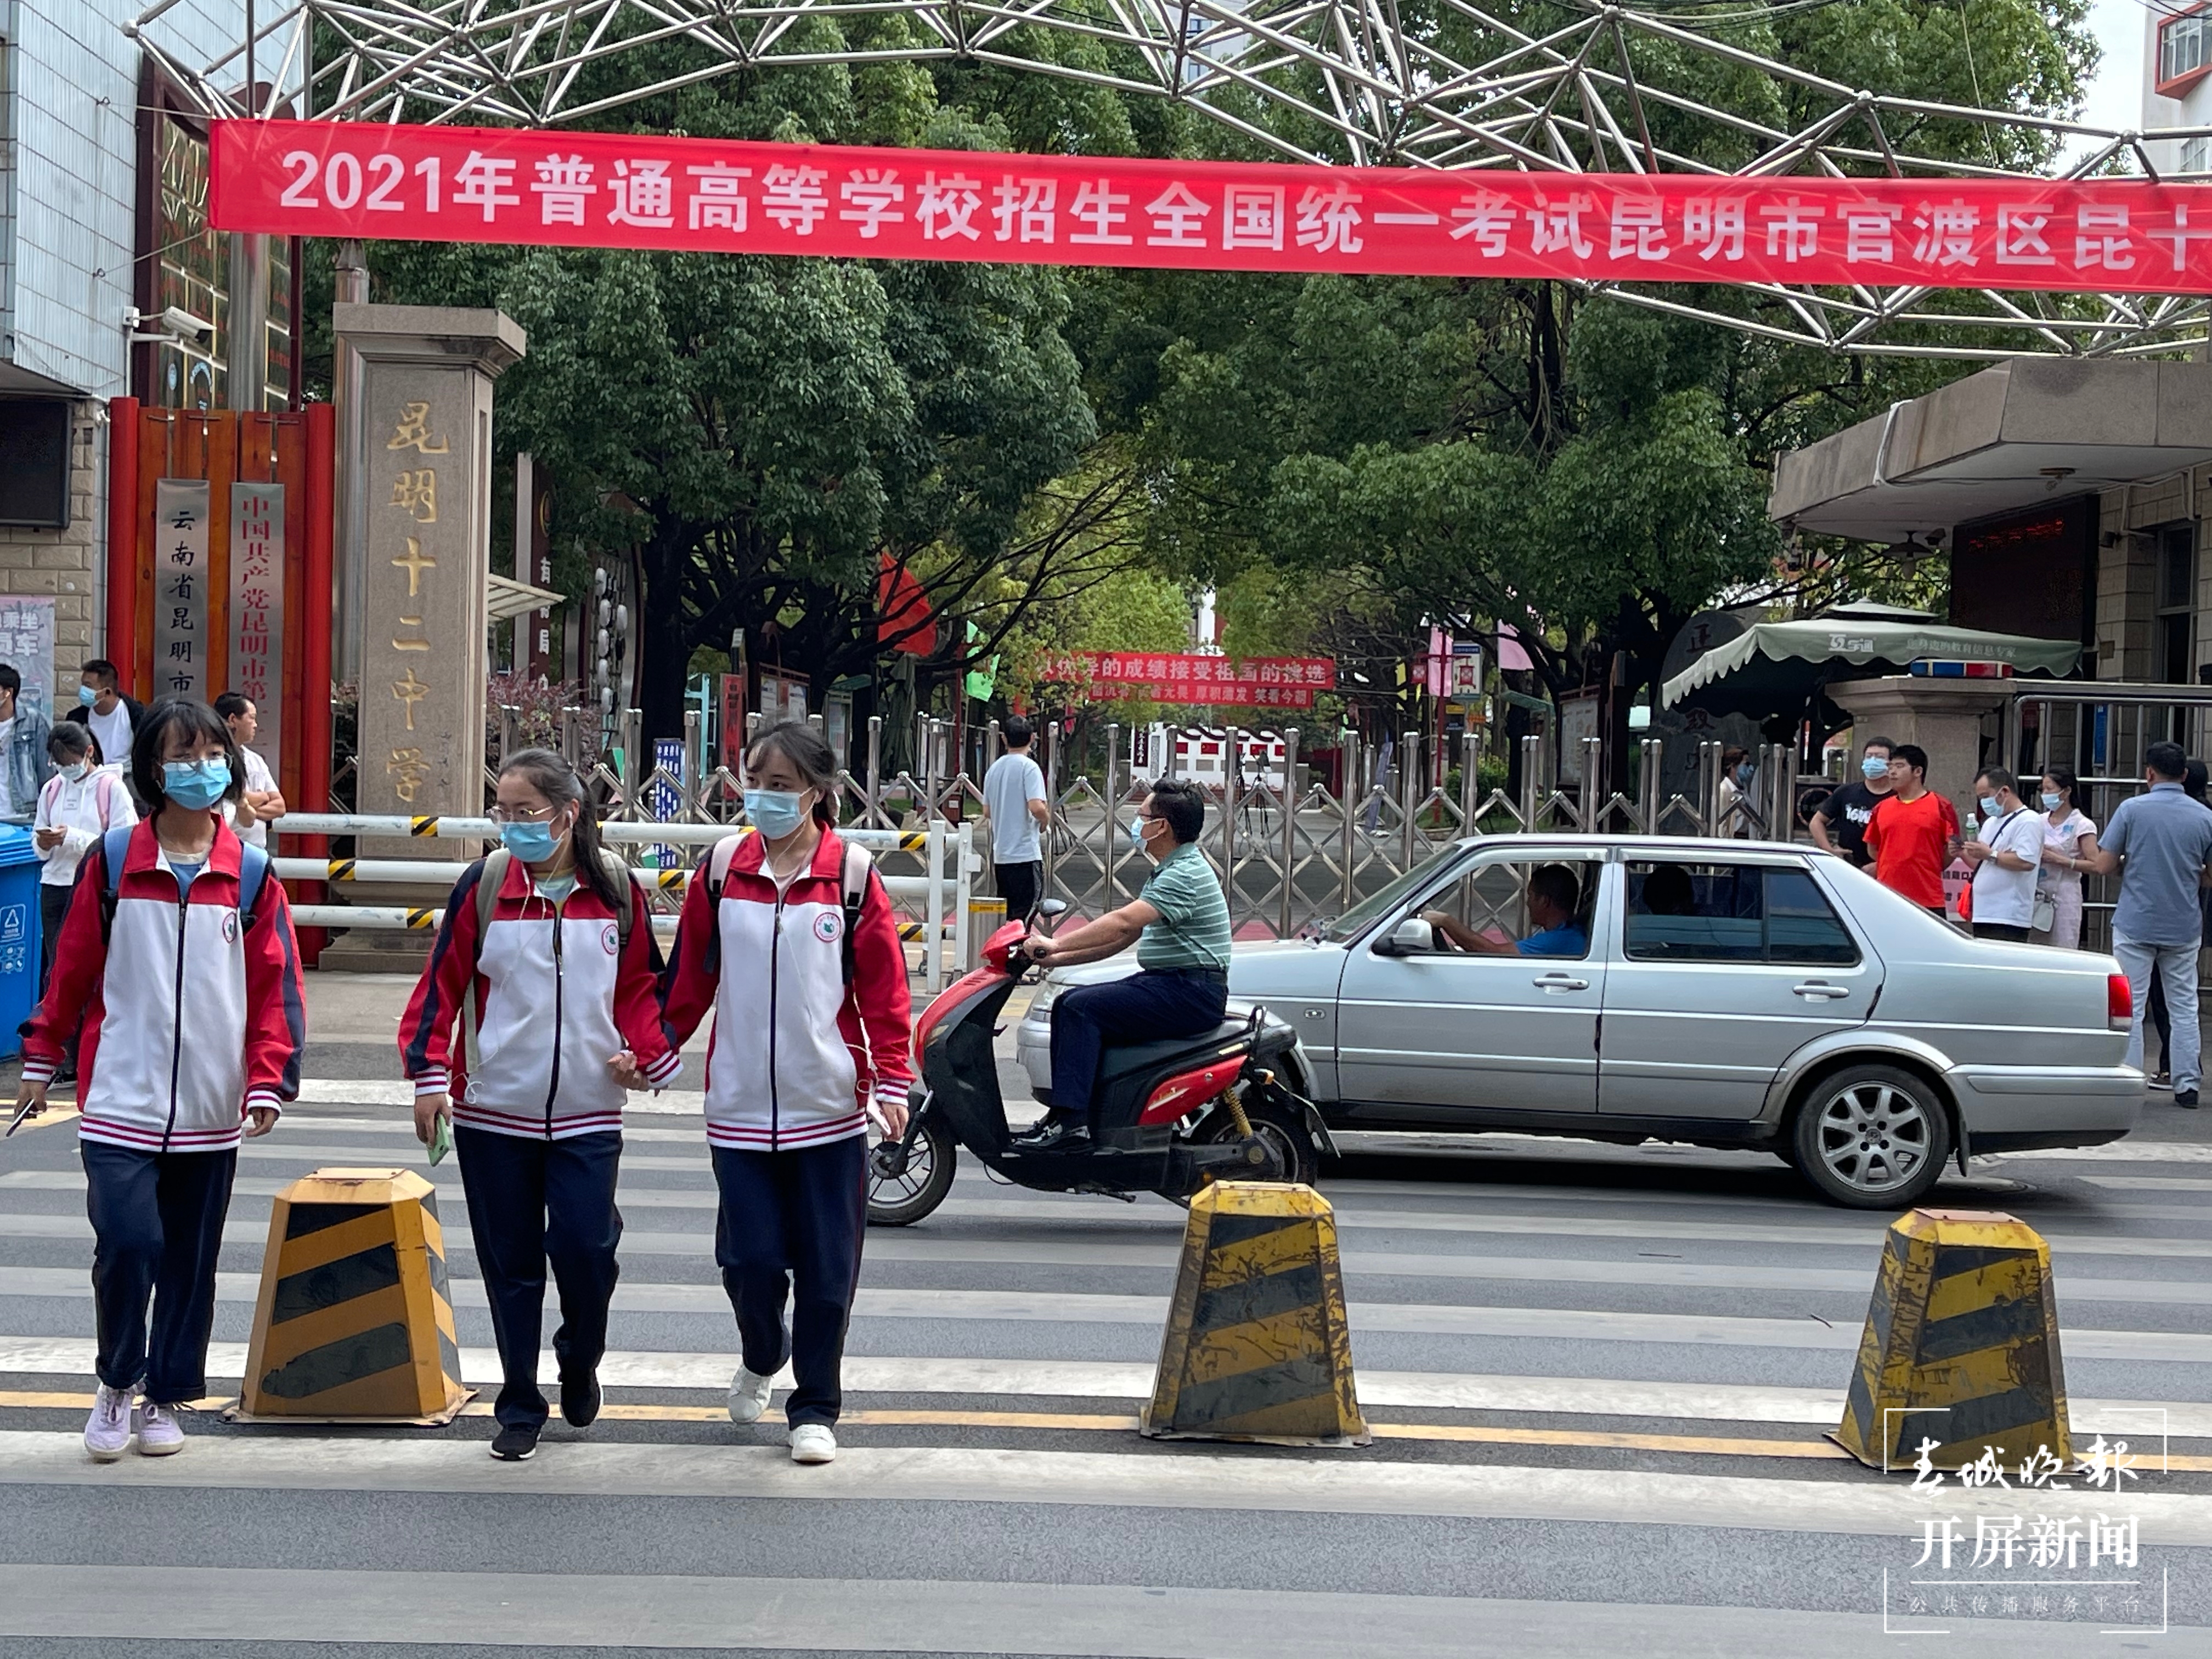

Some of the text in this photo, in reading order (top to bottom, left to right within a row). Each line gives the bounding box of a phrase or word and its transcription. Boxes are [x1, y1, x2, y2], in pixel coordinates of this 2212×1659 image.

[280, 150, 2212, 272] 2021年普通高等学校招生全国统一考试昆明市官渡区昆十
[0, 612, 38, 630] 乘坐
[168, 511, 196, 694] 云南省昆明市
[386, 399, 449, 803] 昆明十二中学
